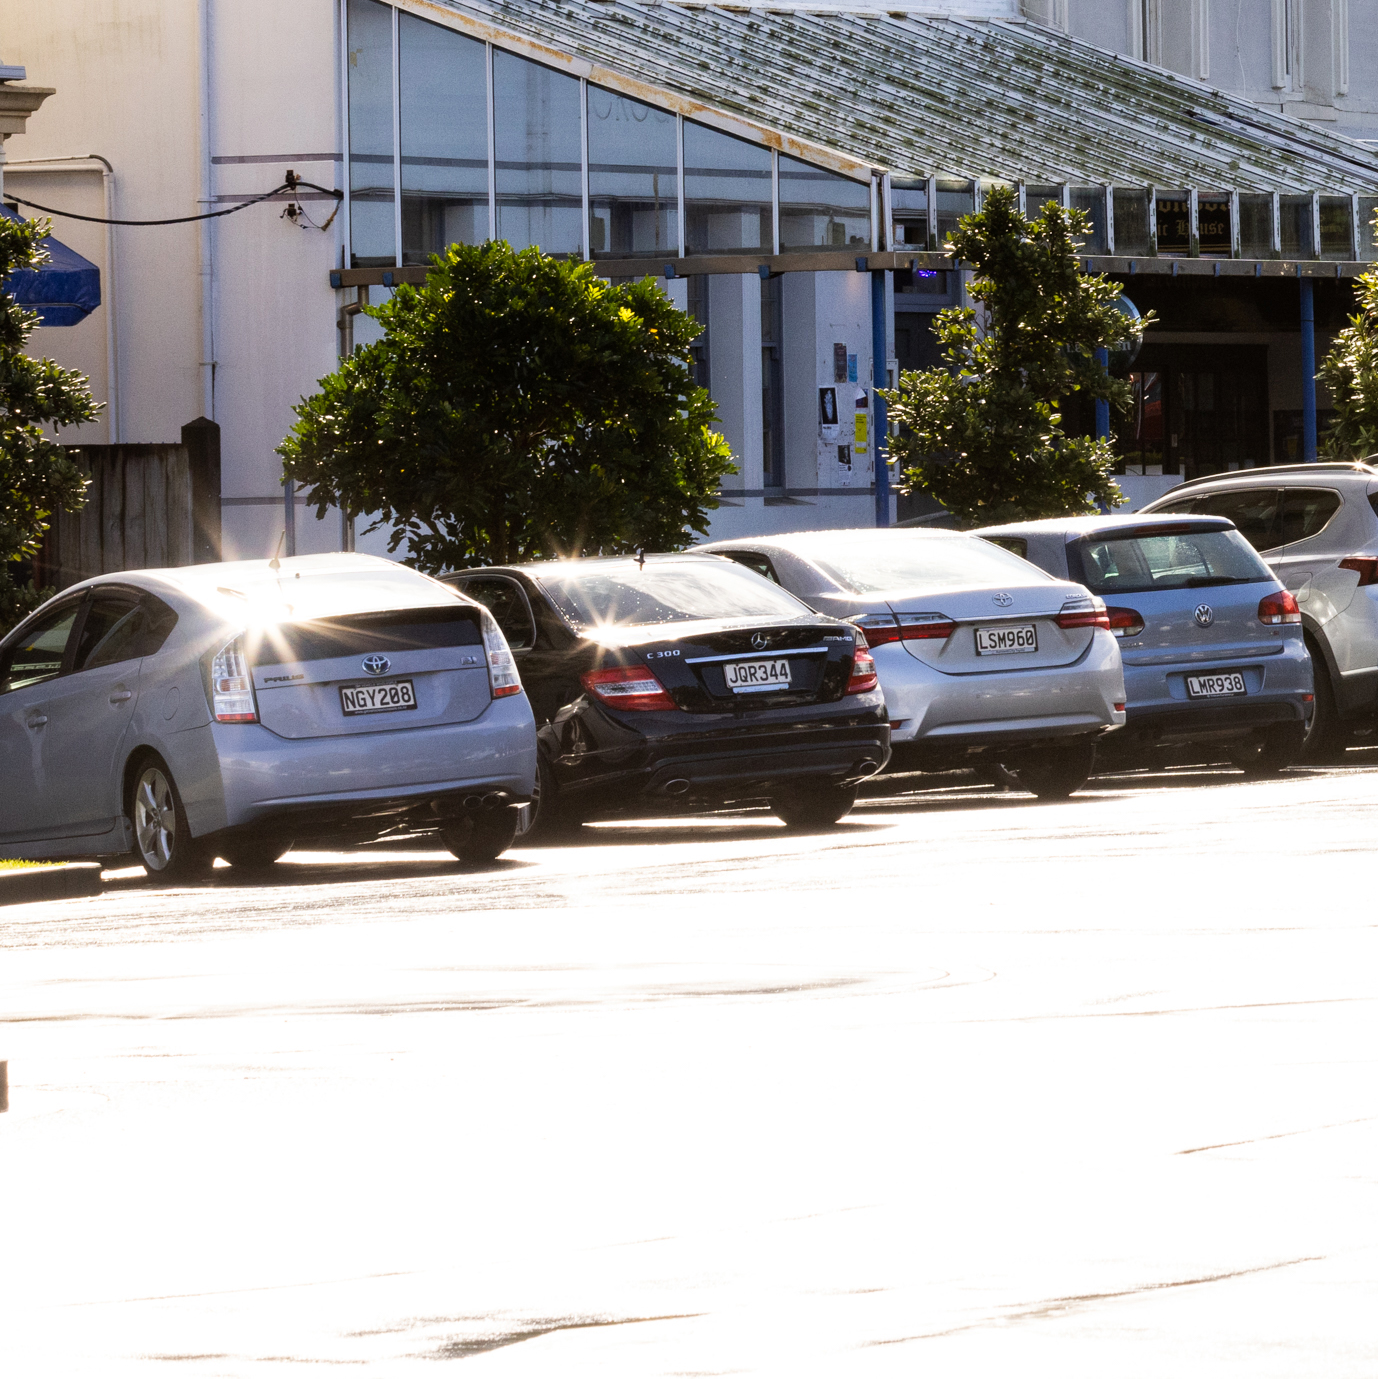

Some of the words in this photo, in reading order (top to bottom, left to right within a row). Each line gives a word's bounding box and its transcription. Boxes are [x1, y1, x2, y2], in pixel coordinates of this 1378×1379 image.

[978, 629, 1034, 650] LSM960
[656, 649, 681, 659] 300
[729, 659, 789, 684] JQR344
[1189, 675, 1243, 695] LMR938
[343, 685, 413, 710] NGY208
